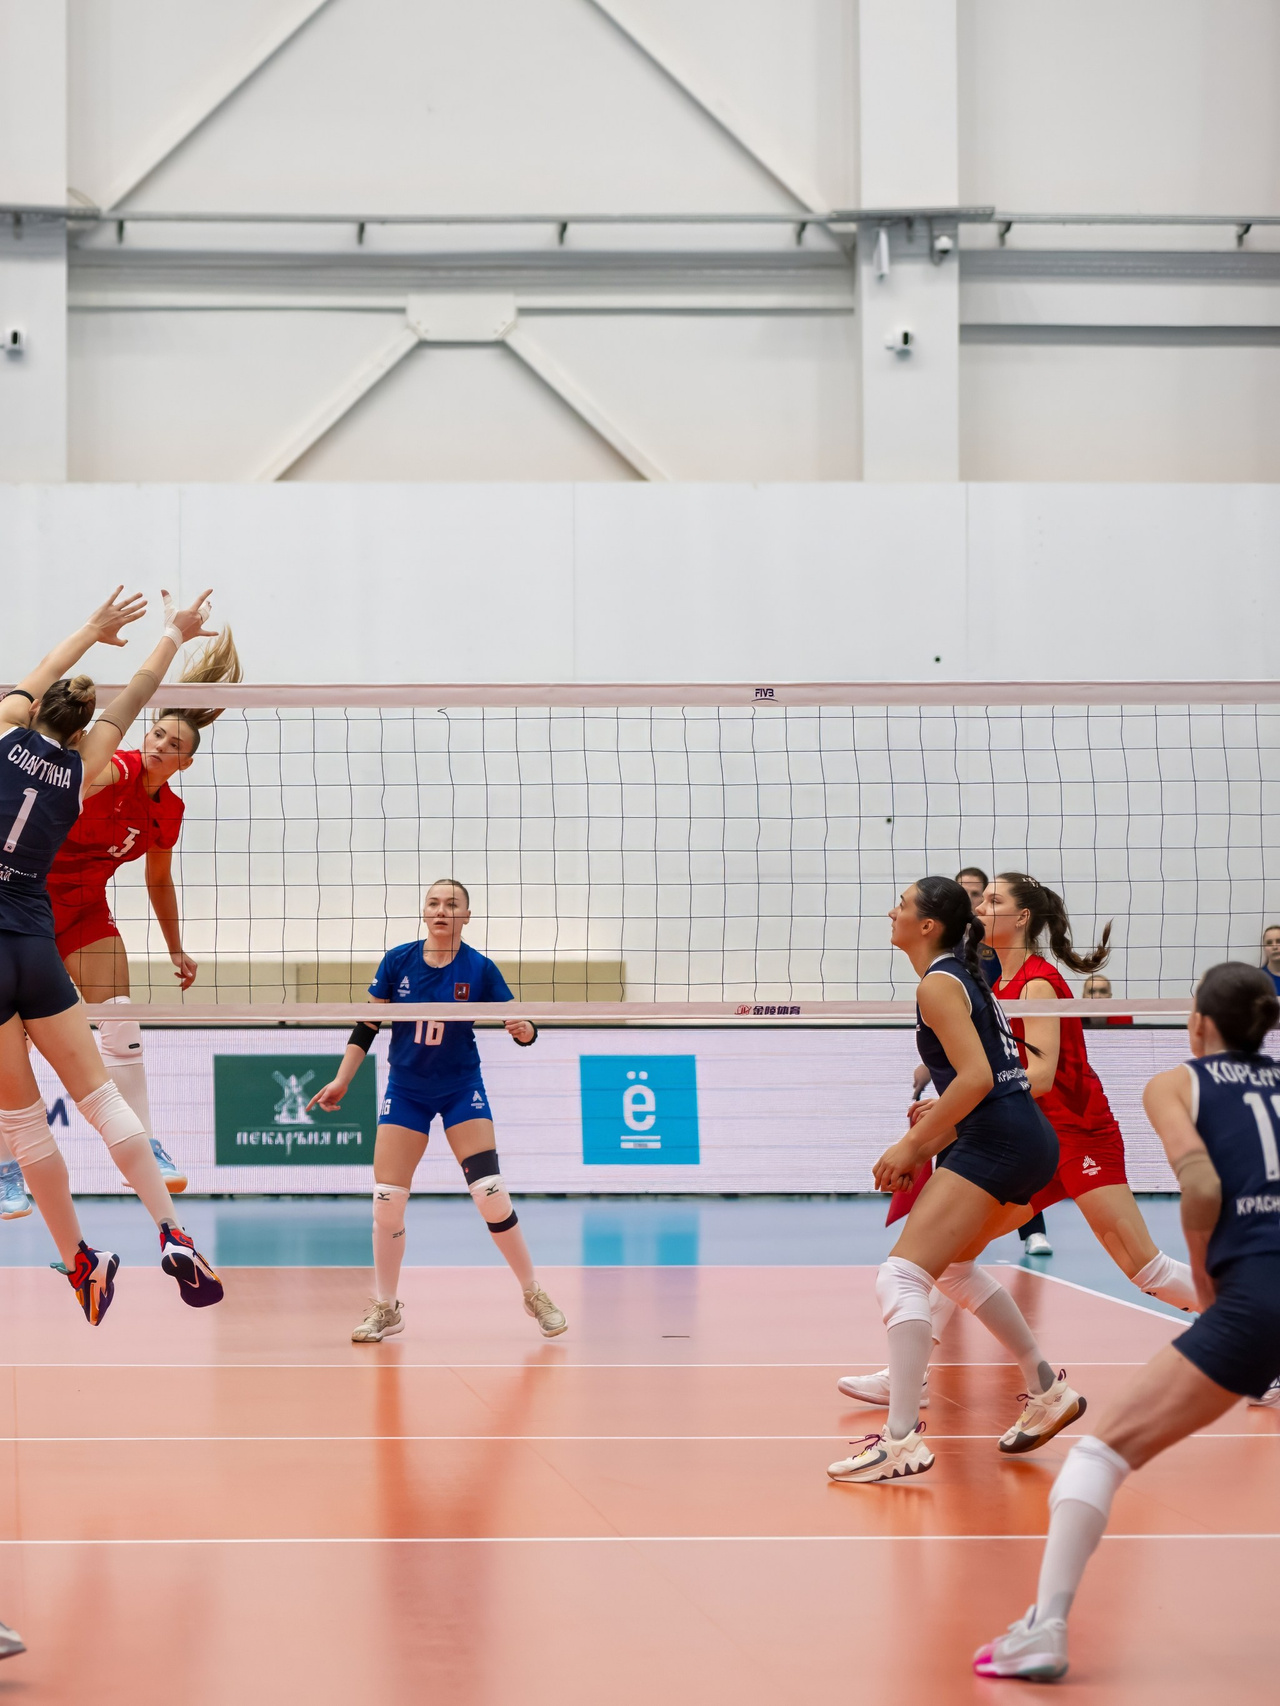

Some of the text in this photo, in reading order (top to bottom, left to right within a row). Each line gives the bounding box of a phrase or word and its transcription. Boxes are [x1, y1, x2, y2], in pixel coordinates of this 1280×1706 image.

[754, 688, 775, 698] FIVB
[7, 743, 72, 789] СЛАУТИНА
[3, 787, 38, 853] 1
